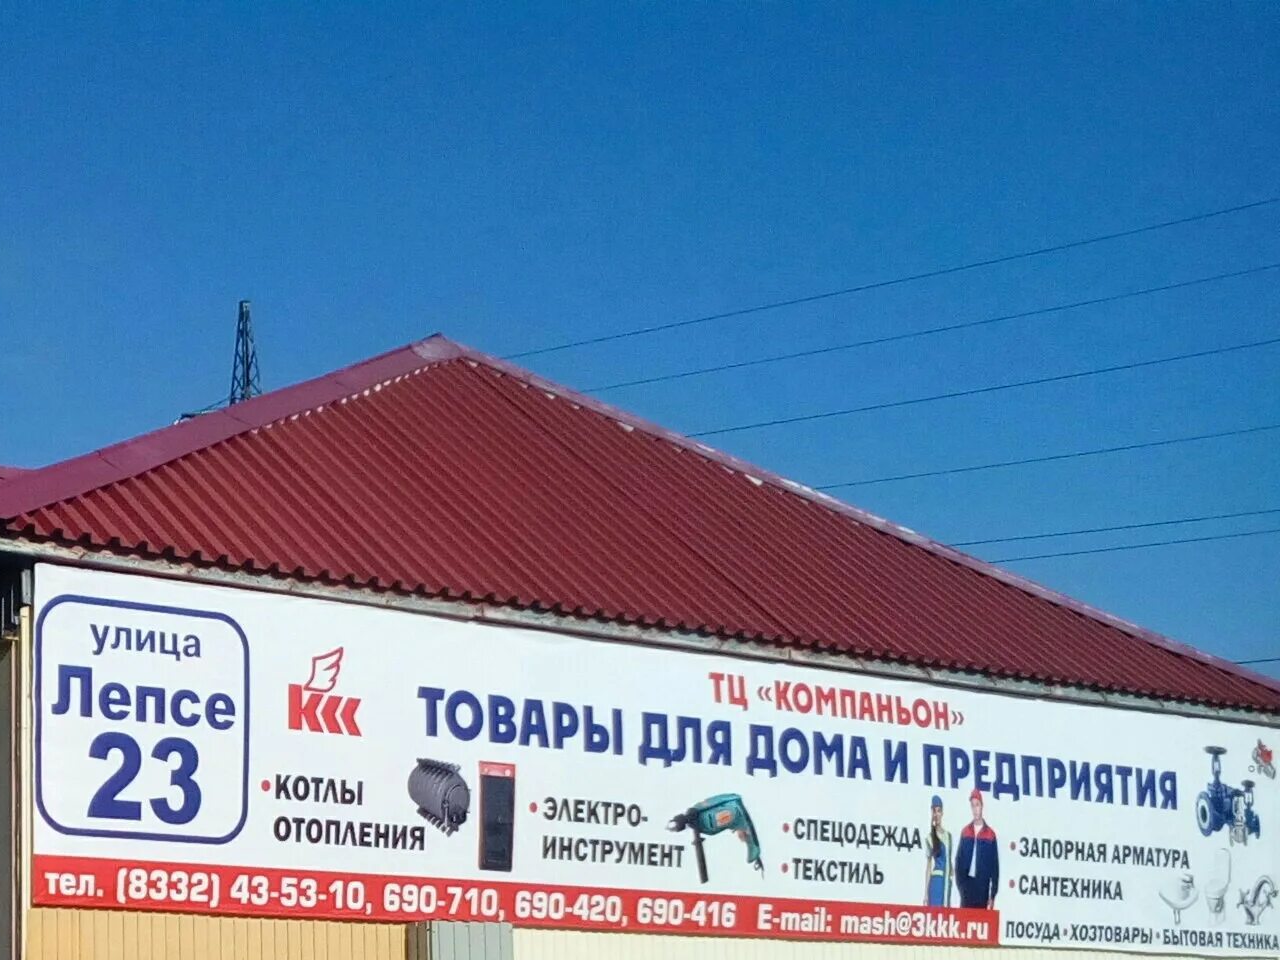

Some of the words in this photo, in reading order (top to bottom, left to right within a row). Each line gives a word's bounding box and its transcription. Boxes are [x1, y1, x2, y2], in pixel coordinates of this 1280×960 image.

[90, 624, 200, 661] улица
[52, 664, 235, 730] Лепсе
[709, 673, 748, 710] ТЦ
[757, 680, 965, 730] «КОМПАНЬОН»
[418, 687, 623, 755] ТОВАРЫ
[639, 712, 732, 768] ДЛЯ
[746, 724, 871, 780] ДОМА
[883, 740, 908, 784] И
[923, 744, 1177, 810] ПРЕДПРИЯТИЯ
[87, 732, 201, 825] 23
[276, 774, 363, 805] КОТЛЫ
[544, 797, 648, 827] ЭЛЕКТРО-
[274, 815, 425, 850] ОТОПЛЕНИЯ
[794, 819, 922, 852] СПЕЦОДЕЖДА
[543, 836, 684, 867] ИНСТРУМЕНТ
[1020, 837, 1106, 862] ЗАПОРНАЯ
[1112, 845, 1189, 869] АРМАТУРА
[793, 858, 884, 884] ТЕКСТИЛЬ
[1019, 875, 1122, 900] САНТЕХНИКА
[45, 873, 103, 896] тел.
[117, 868, 219, 907] (8332)
[231, 875, 372, 914] 43-53-10,
[384, 884, 505, 921] 690-710,
[515, 890, 628, 927] 690-420,
[637, 898, 736, 928] 690-416
[758, 904, 832, 932] E-mail:
[840, 911, 988, 940] mash@3kkk.ru
[1006, 921, 1060, 942] ПОСУДА
[1070, 925, 1152, 944] ХОЗТОВАРЫ
[1163, 929, 1223, 947] БЫТОВАЯ
[1226, 932, 1279, 950] ТЕХНИКА
